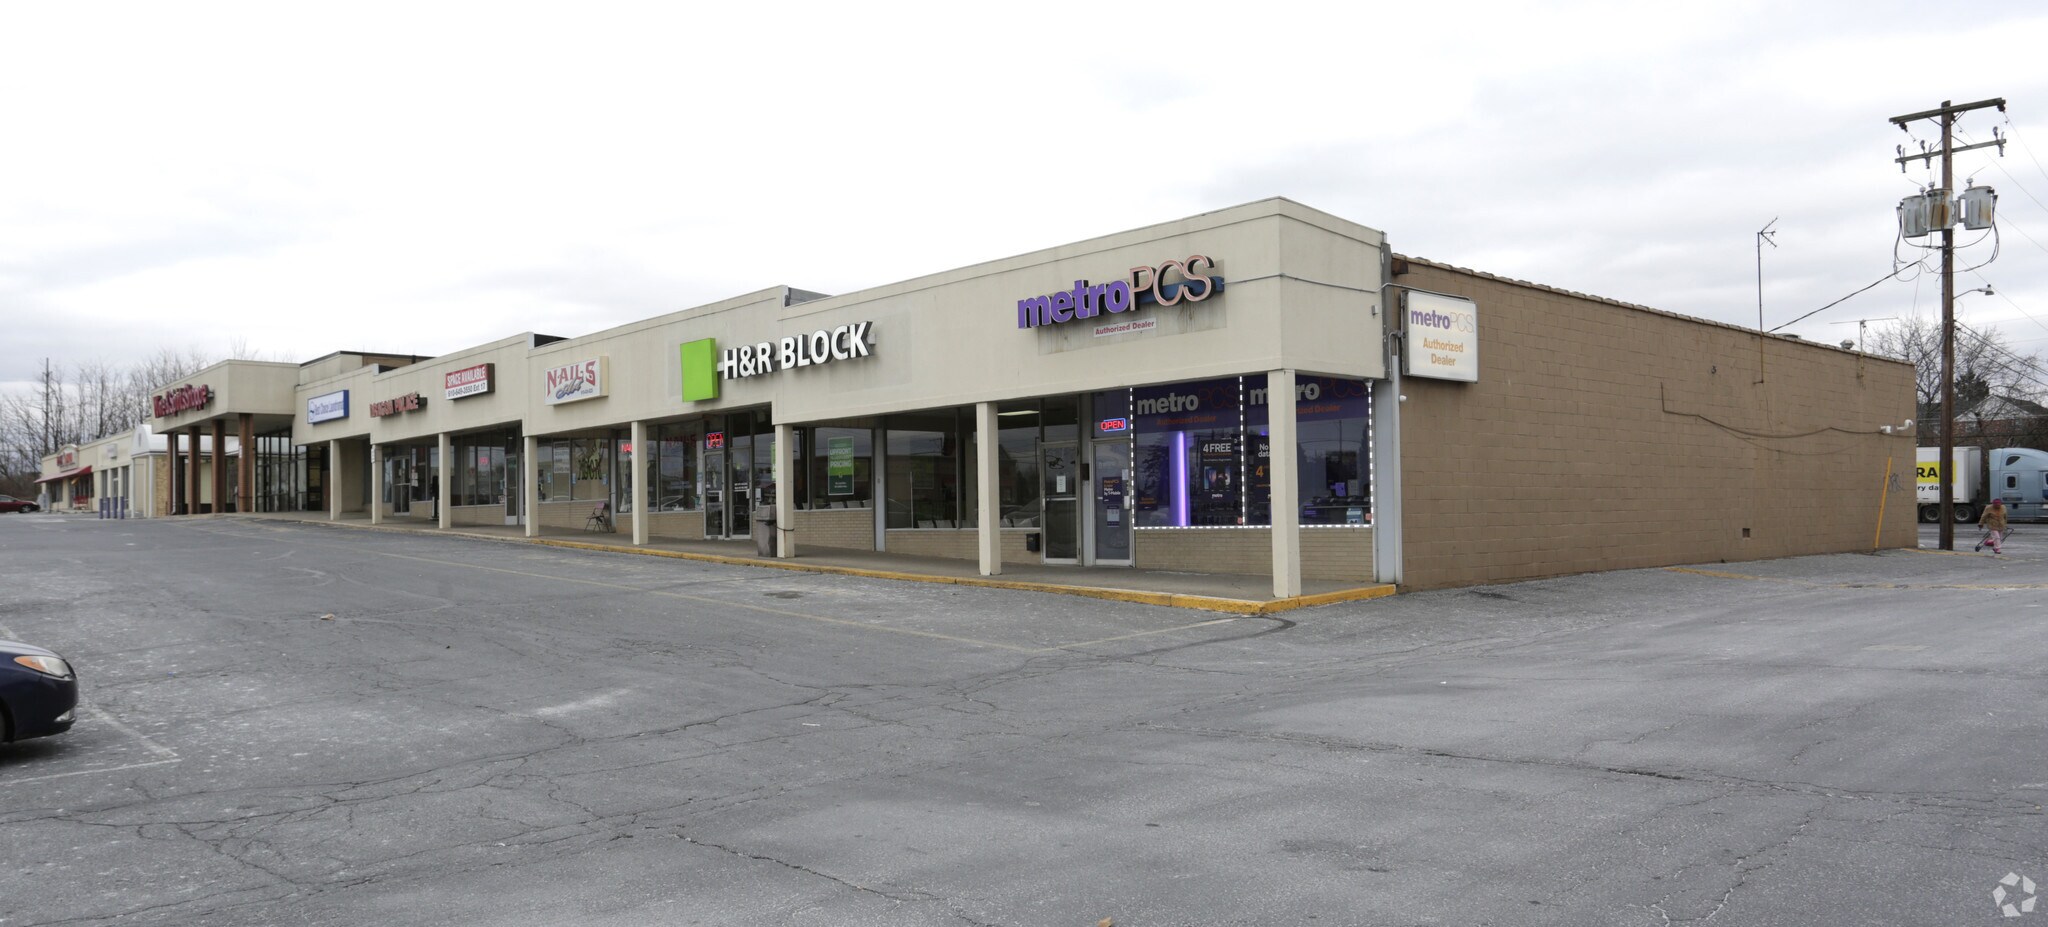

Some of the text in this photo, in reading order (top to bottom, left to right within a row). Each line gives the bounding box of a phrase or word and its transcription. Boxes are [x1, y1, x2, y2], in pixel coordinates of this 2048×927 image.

[1018, 255, 1213, 329] metroPCS
[1095, 320, 1155, 335] Authorized Dealer
[1411, 310, 1474, 334] metroPCS
[724, 321, 871, 379] H&R BLOCK
[1423, 337, 1464, 353] Authorized
[1431, 353, 1456, 366] Dealer
[447, 365, 486, 387] SPACE AVAILABLE
[1101, 421, 1124, 431] OPEN
[708, 433, 724, 448] OPEN
[1203, 444, 1209, 453] 4
[1209, 443, 1232, 453] FREE
[1259, 443, 1269, 451] No
[1256, 465, 1264, 478] 4
[1916, 467, 1938, 478] RA
